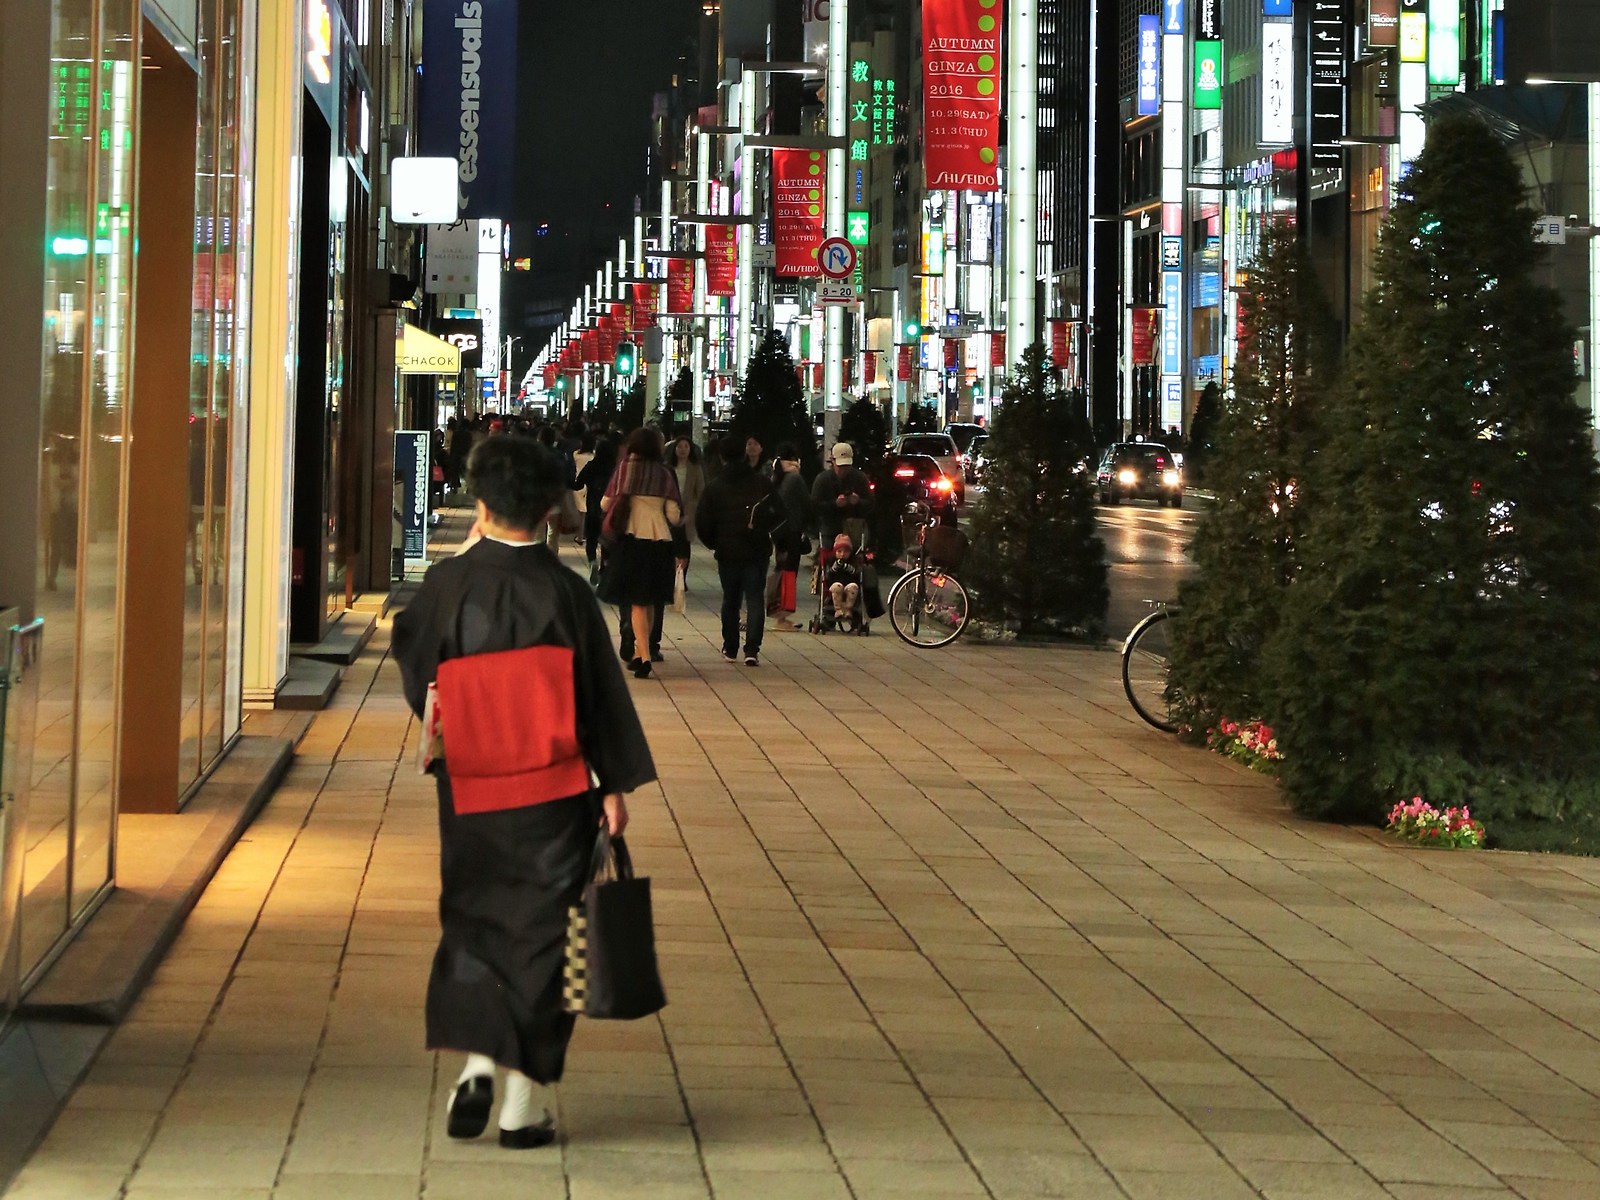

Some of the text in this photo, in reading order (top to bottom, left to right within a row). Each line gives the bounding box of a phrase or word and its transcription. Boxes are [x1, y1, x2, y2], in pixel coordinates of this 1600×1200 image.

[929, 38, 995, 50] AUTUMN
[929, 61, 976, 73] GINZA
[454, 0, 483, 183] essensuals
[930, 85, 963, 96] 2016
[852, 61, 869, 161] 教文館
[873, 79, 883, 145] 教文館ビル
[886, 79, 895, 145] 教文館ビル
[930, 110, 990, 120] 10.29(SAT)
[777, 179, 820, 187] AUTUMN
[932, 171, 995, 186] SHISEIDO
[780, 264, 819, 273] SHISEIDO
[403, 356, 455, 366] CHACOK
[413, 434, 426, 514] essensuals
